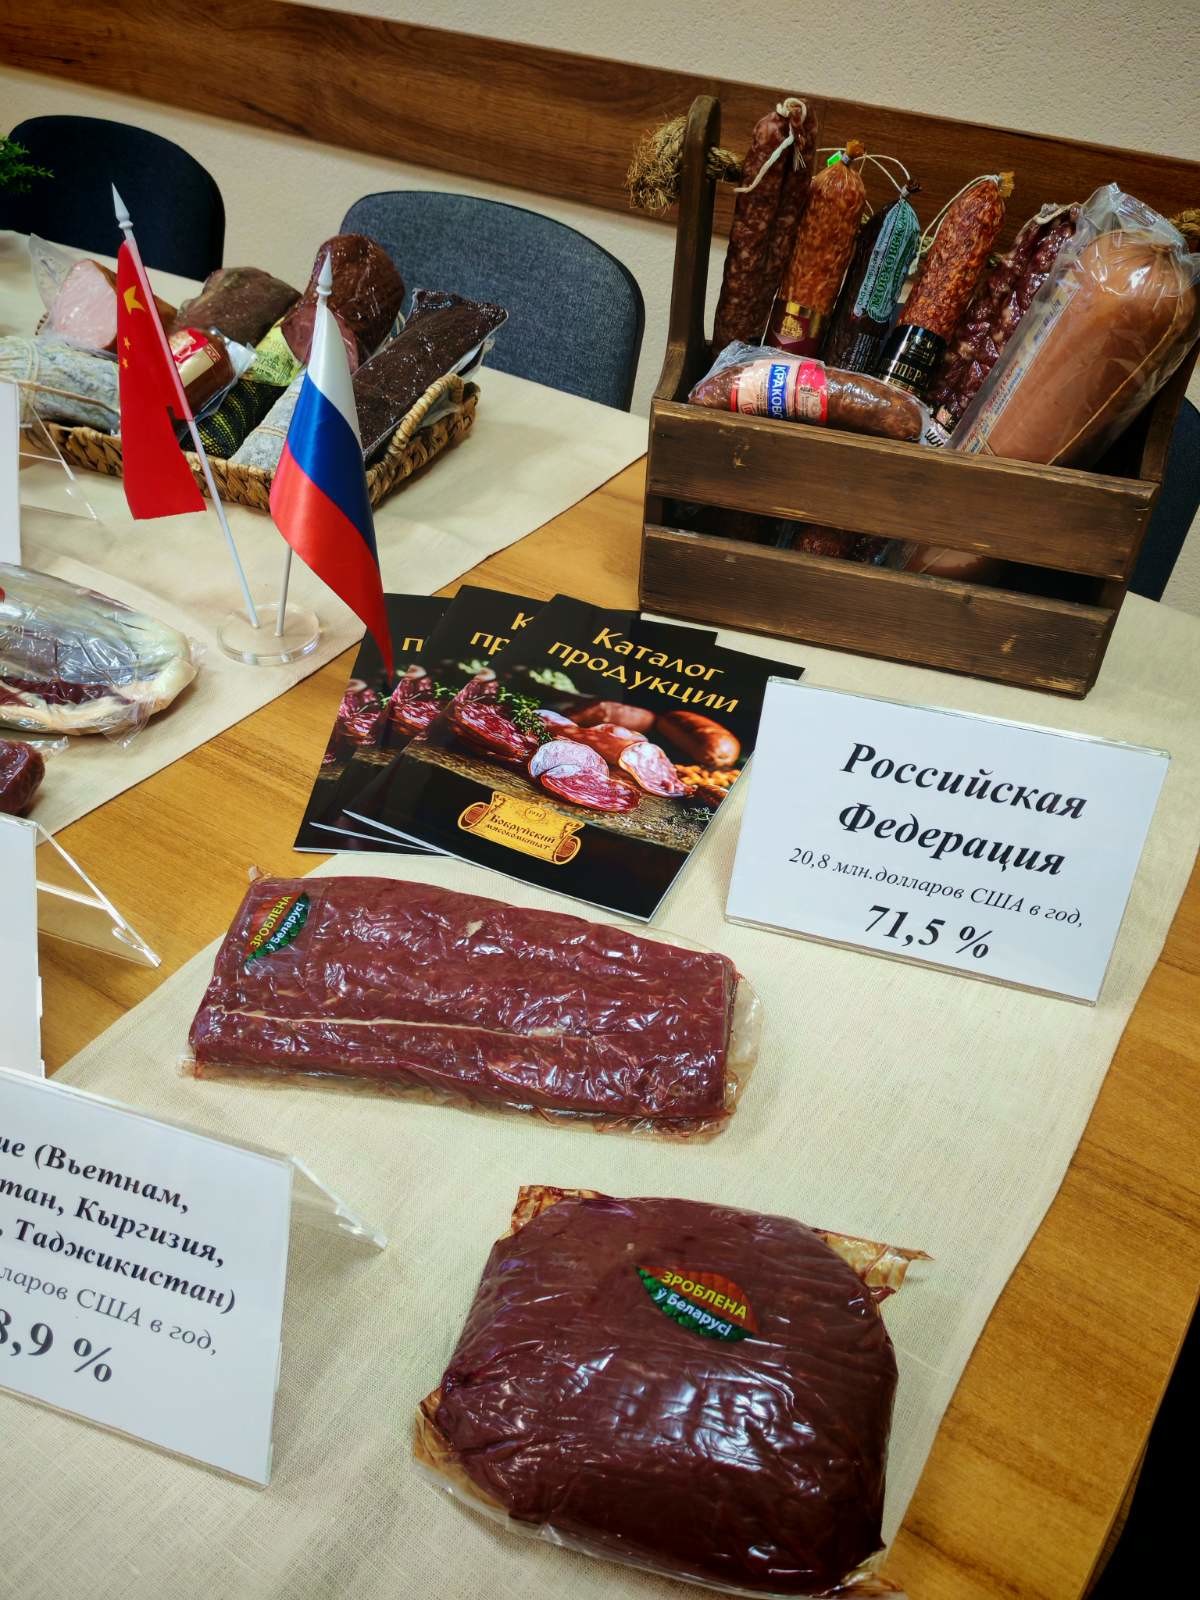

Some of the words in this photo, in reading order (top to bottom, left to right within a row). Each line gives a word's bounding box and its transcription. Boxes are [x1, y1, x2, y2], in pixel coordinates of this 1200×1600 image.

[547, 641, 740, 713] продукции
[592, 627, 725, 683] Каталог
[839, 742, 1088, 819] Российская
[838, 802, 1067, 876] Федерация
[249, 896, 293, 948] ЗРОБЛЕНА
[270, 902, 305, 944] Беларусі
[789, 847, 831, 870] 20,8
[832, 860, 965, 900] млн.долларов
[969, 886, 1026, 913] США
[1029, 903, 1042, 917] в
[1044, 906, 1084, 929] год,
[865, 904, 946, 947] 71,5
[955, 925, 993, 959] %
[34, 1143, 189, 1215] (Вьетнам,
[15, 1218, 236, 1315] Таджикистан)
[73, 1195, 225, 1269] Кыргизия,
[76, 1287, 144, 1327] США
[150, 1317, 164, 1334] в
[169, 1327, 217, 1357] год,
[660, 1271, 748, 1319] ЗРОБЛЕНА
[667, 1293, 733, 1337] Беларусі
[73, 1338, 113, 1383] %
